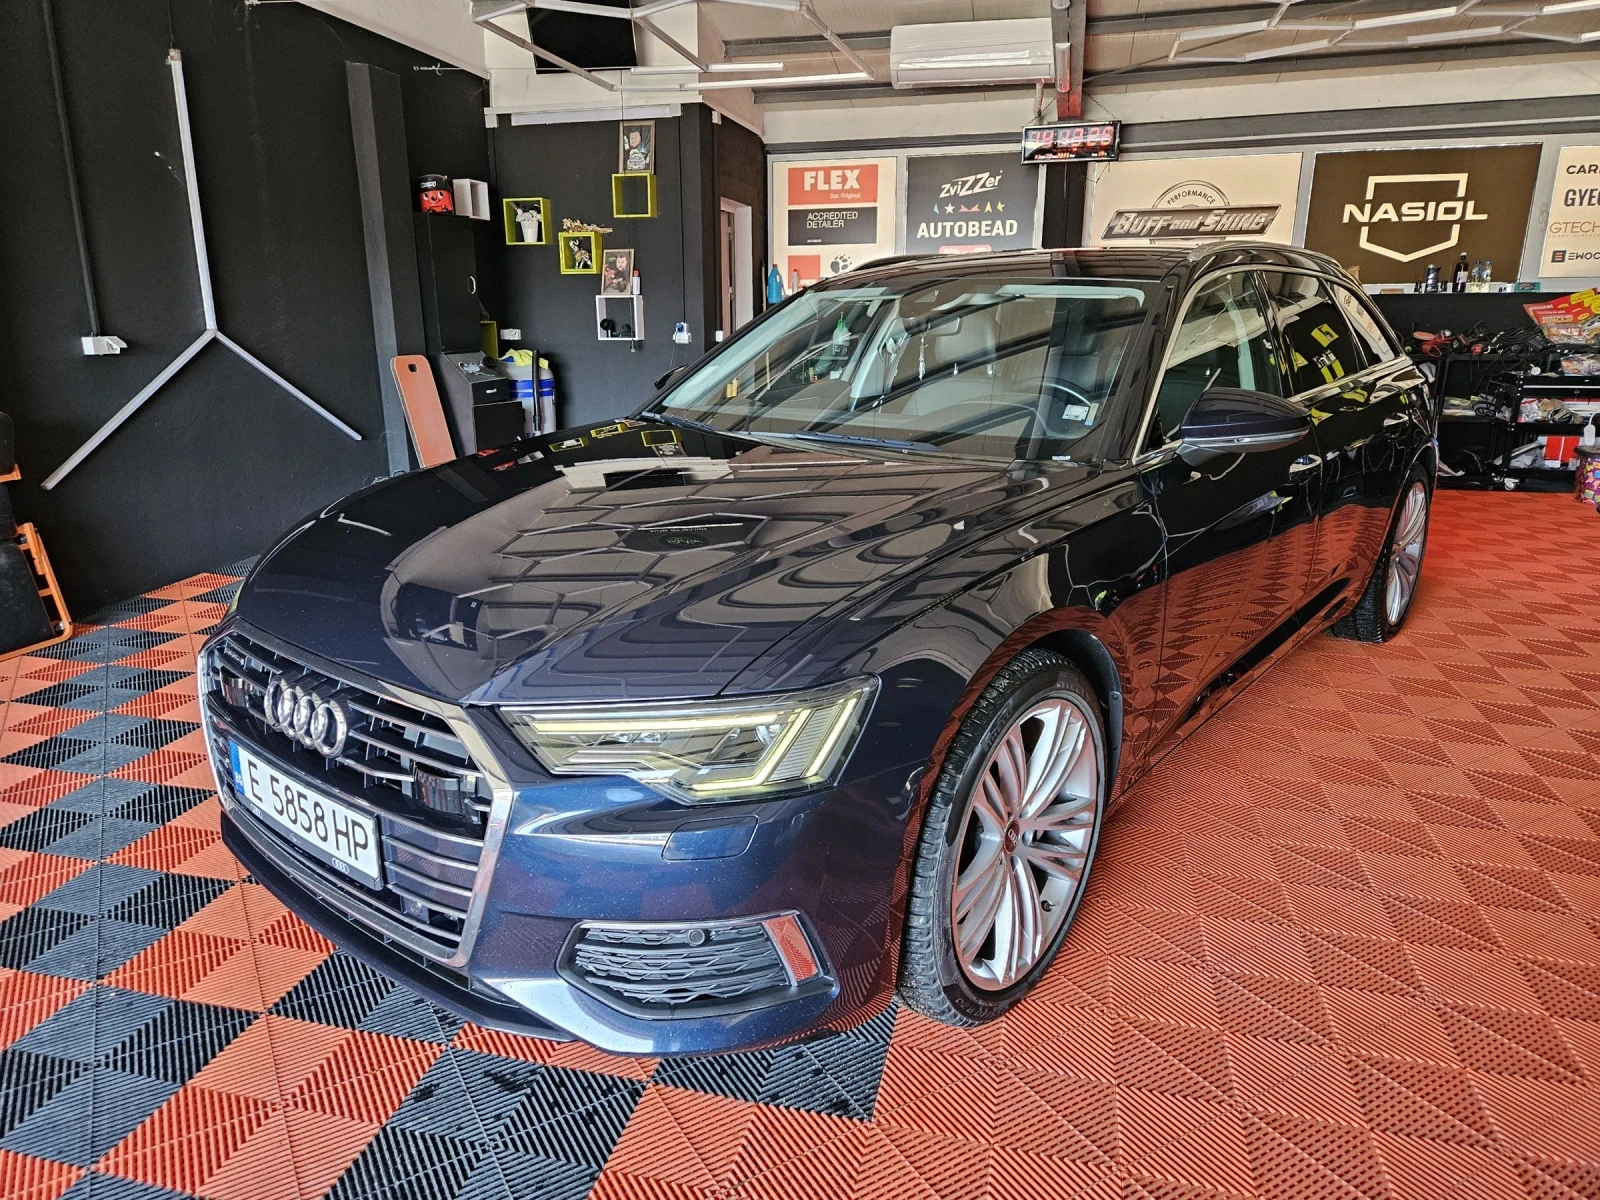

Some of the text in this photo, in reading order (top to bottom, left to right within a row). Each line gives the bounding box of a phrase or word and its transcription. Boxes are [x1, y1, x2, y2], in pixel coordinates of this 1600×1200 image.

[1566, 164, 1600, 175] CAR
[803, 169, 861, 191] FLEX
[840, 192, 861, 200] Original
[1167, 189, 1216, 205] PERFORMANCE
[1563, 188, 1600, 207] GYE
[807, 211, 859, 221] ACCREDITED
[1342, 200, 1488, 223] NASIOL
[806, 220, 845, 229] DETAILER
[916, 219, 1018, 239] AUTOBEAD
[1169, 216, 1203, 231] and
[247, 758, 369, 862] E 5858 HP
